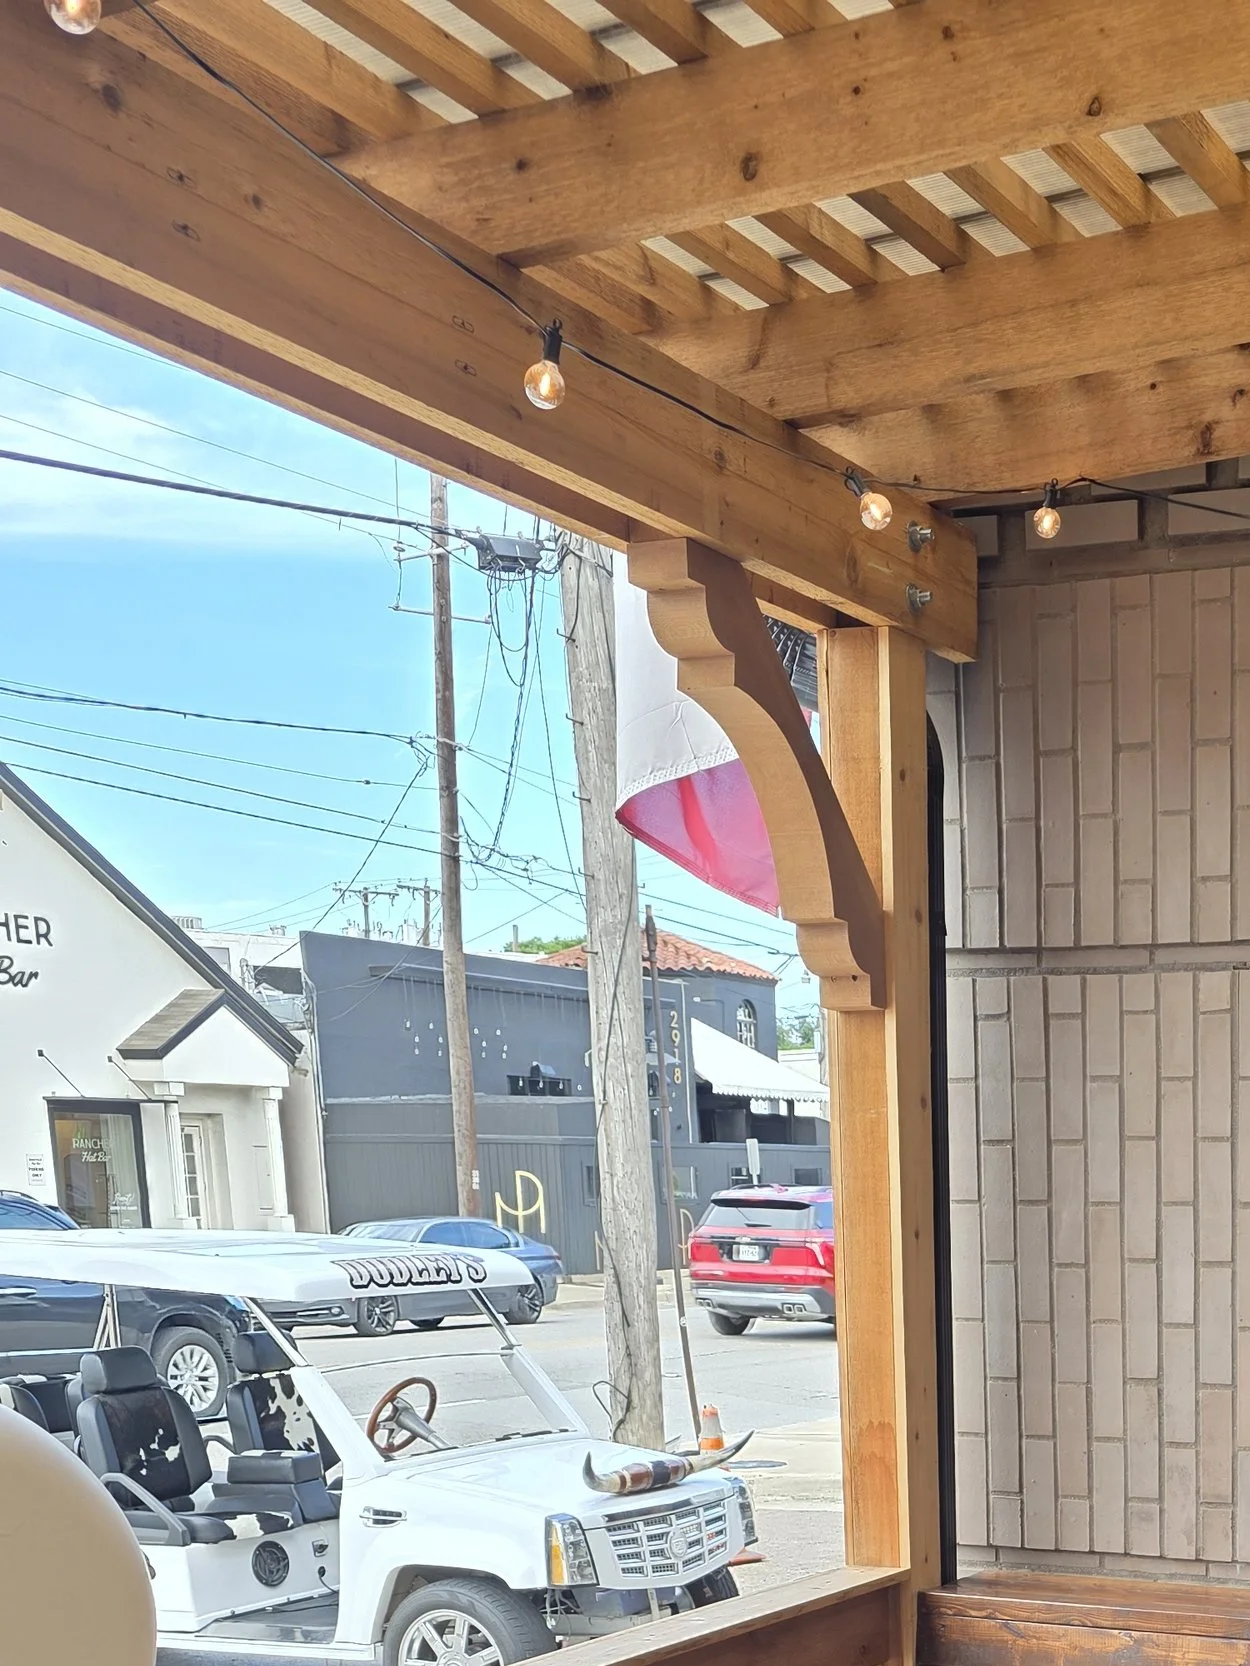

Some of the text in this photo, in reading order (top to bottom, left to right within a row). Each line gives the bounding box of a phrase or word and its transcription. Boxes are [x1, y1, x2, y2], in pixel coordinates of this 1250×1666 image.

[669, 1010, 682, 1084] 2918
[81, 1151, 111, 1162] Hat Bar
[330, 1252, 488, 1289] DUDLEY'S
